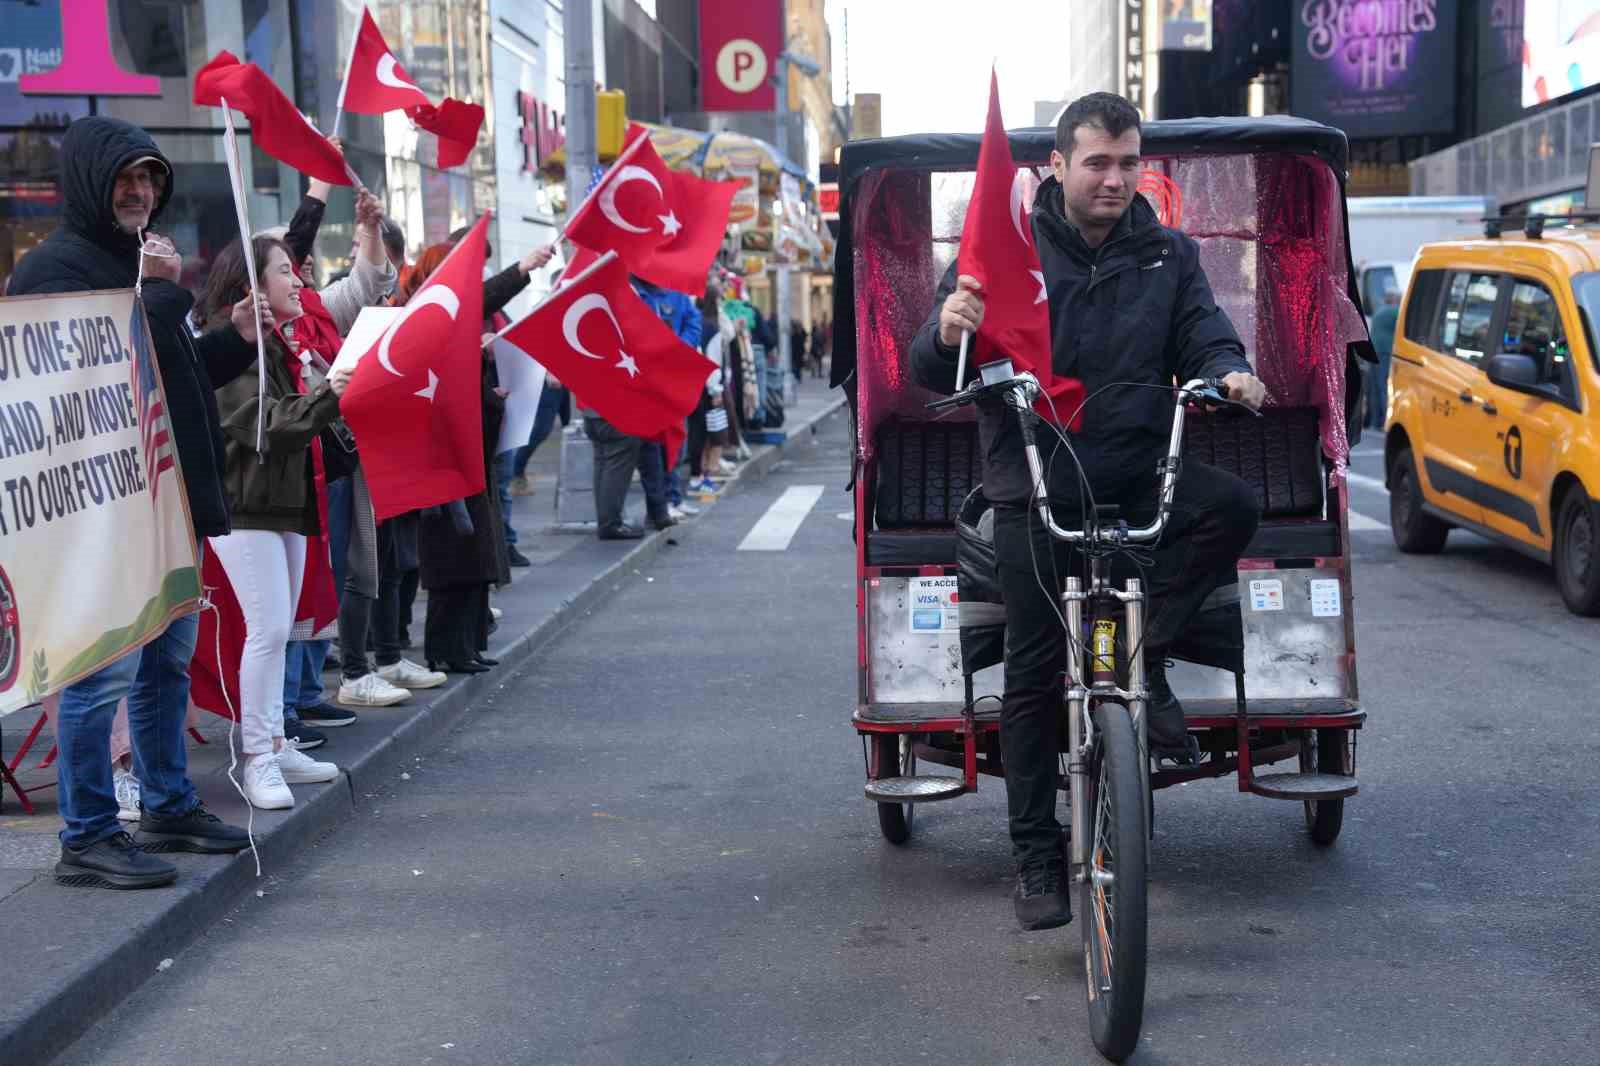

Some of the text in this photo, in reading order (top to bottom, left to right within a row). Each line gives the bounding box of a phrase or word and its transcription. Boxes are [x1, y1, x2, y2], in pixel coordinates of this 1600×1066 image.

[733, 51, 755, 83] P
[50, 391, 86, 446] AND
[85, 382, 138, 436] MOVE
[4, 475, 35, 531] TO
[38, 464, 77, 522] OUR
[917, 595, 938, 604] VISA
